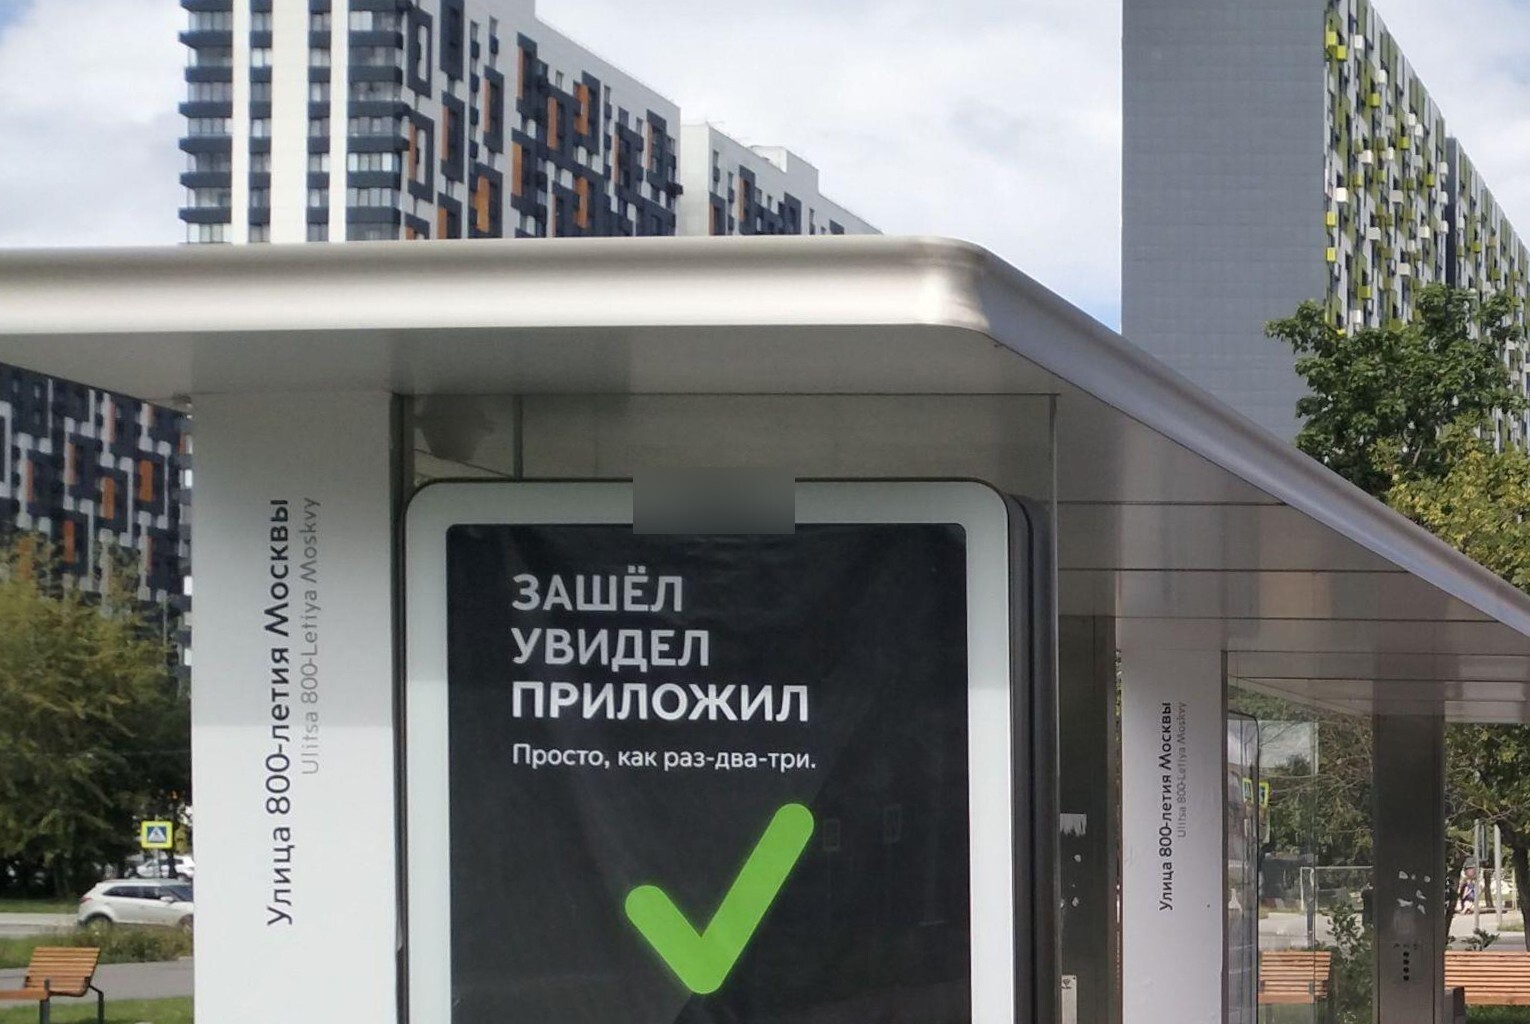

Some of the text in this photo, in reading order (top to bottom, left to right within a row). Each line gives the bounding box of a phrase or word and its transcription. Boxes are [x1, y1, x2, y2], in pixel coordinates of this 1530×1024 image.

[511, 564, 684, 613] ЗАШЁЛ
[298, 496, 322, 775] Ulitsa 800-Letiya Moskvy
[511, 627, 710, 673] УВИДЕЛ
[263, 499, 295, 926] Улица 800-летия Москвы
[511, 681, 810, 722] ПРИЛОЖИЛ
[512, 743, 816, 773] Просто, как раз-два-три.
[1158, 702, 1174, 912] Улица 800-летия Москвы
